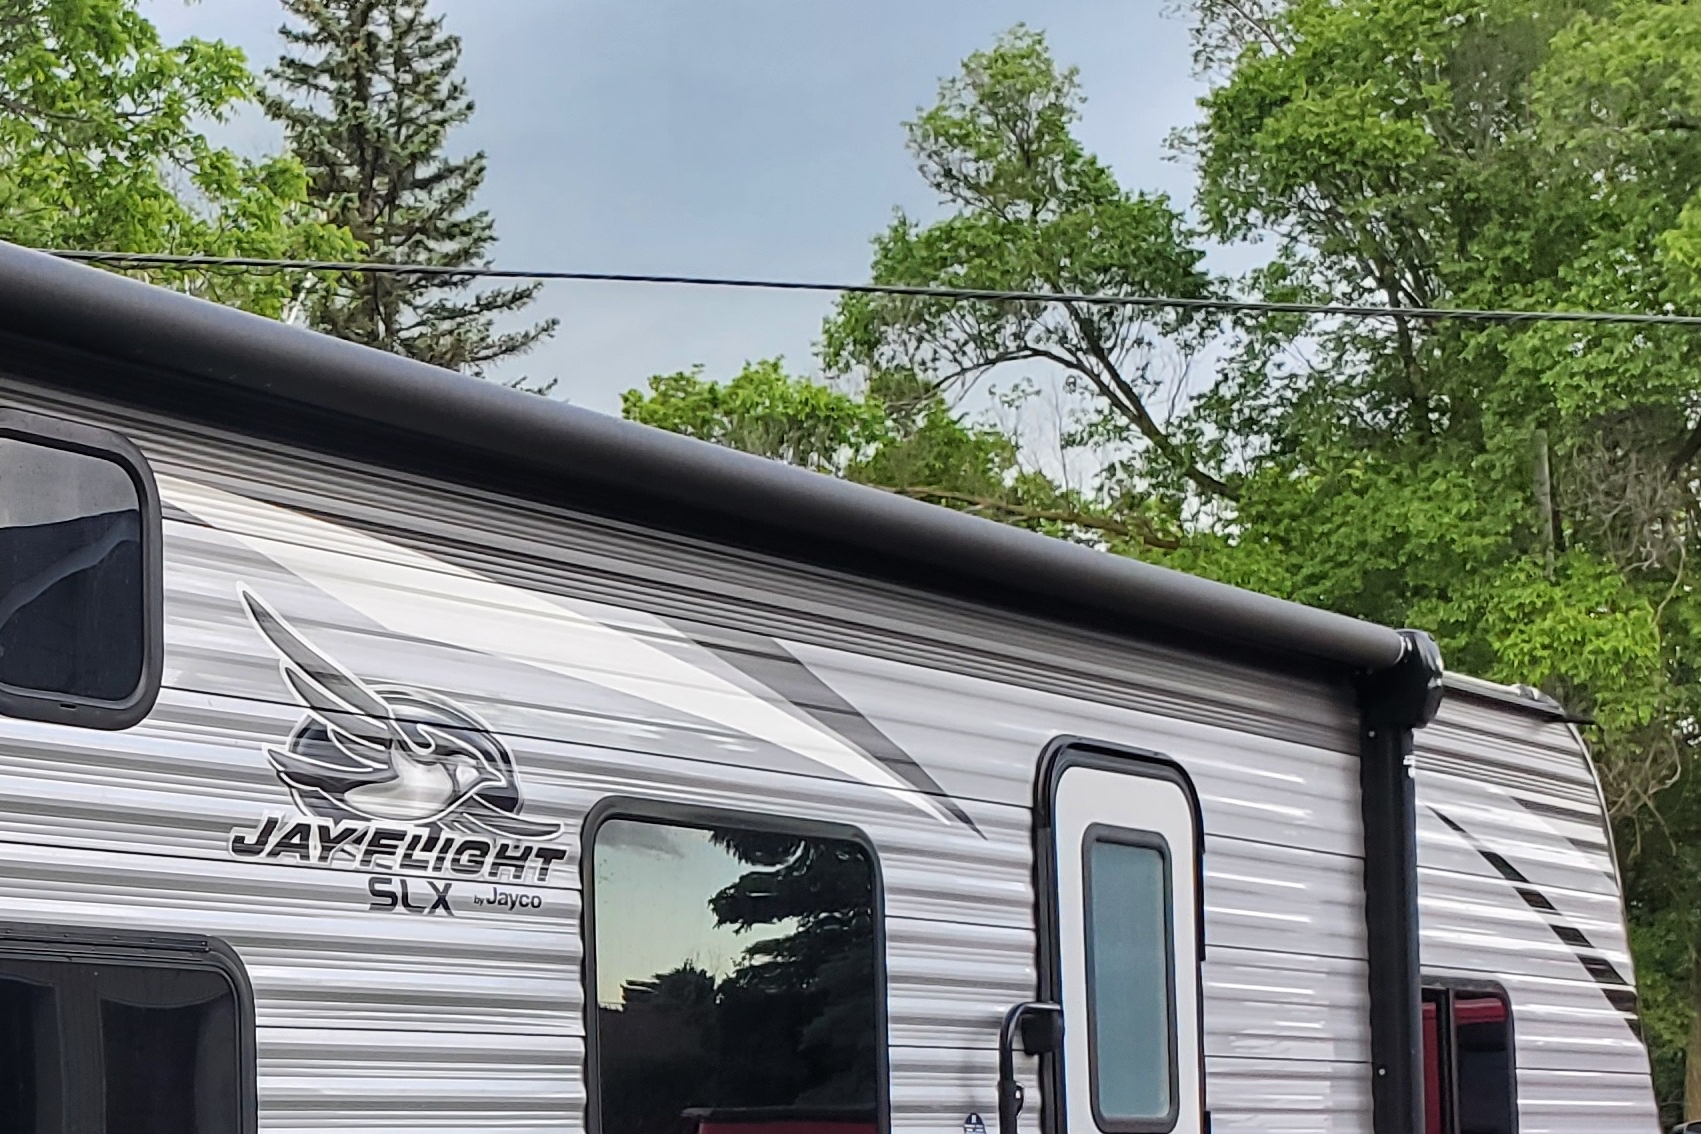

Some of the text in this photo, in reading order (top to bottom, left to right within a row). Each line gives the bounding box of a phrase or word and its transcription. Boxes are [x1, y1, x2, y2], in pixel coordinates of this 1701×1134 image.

[367, 876, 543, 916] SLX by Jayco
